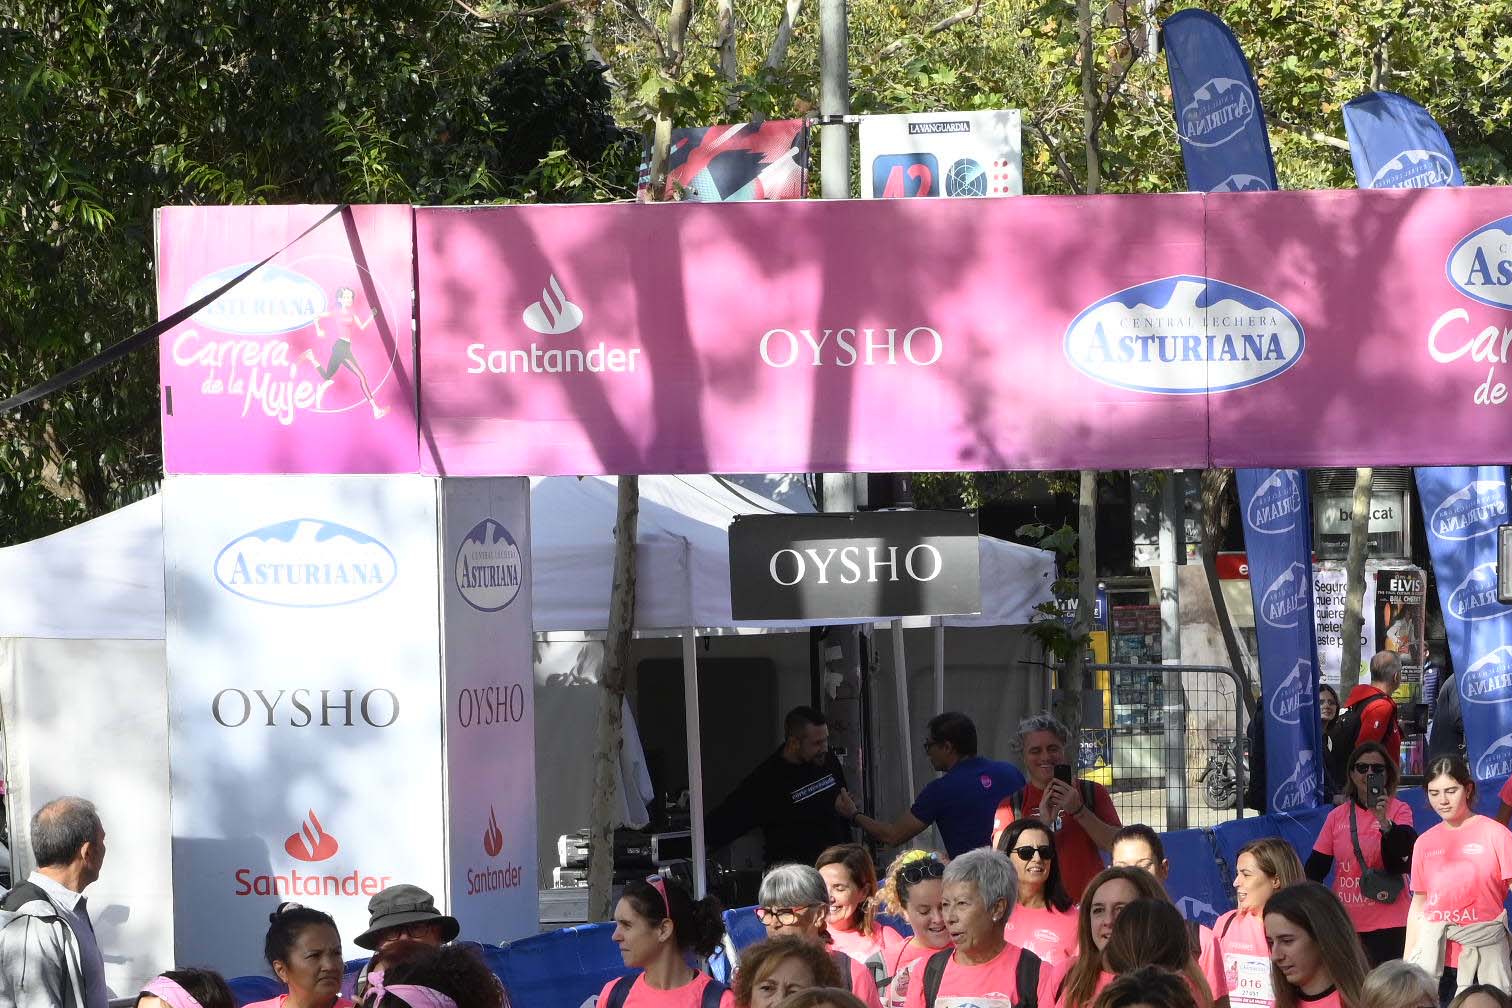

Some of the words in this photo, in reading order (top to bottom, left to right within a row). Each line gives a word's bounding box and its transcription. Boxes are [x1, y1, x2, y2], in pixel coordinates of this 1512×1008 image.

[1120, 317, 1194, 329] CENTRAL
[1202, 315, 1279, 328] LECHERA
[172, 329, 291, 368] Carrera
[466, 343, 641, 375] Santander
[759, 327, 943, 368] OYSHO
[1085, 321, 1288, 363] ASTURIANA
[201, 370, 223, 395] de
[228, 364, 244, 395] la
[241, 362, 335, 426] Mujer
[1473, 367, 1508, 405] de
[230, 551, 384, 586] ASTURIANA
[461, 553, 519, 588] ASTURIANA
[769, 544, 943, 586] OYSHO
[1390, 579, 1421, 592] ELVIS
[211, 688, 400, 727] OYSHO
[458, 684, 525, 728] OYSHO
[235, 868, 392, 897] Santander
[467, 861, 523, 896] Santander
[1240, 979, 1262, 989] 016
